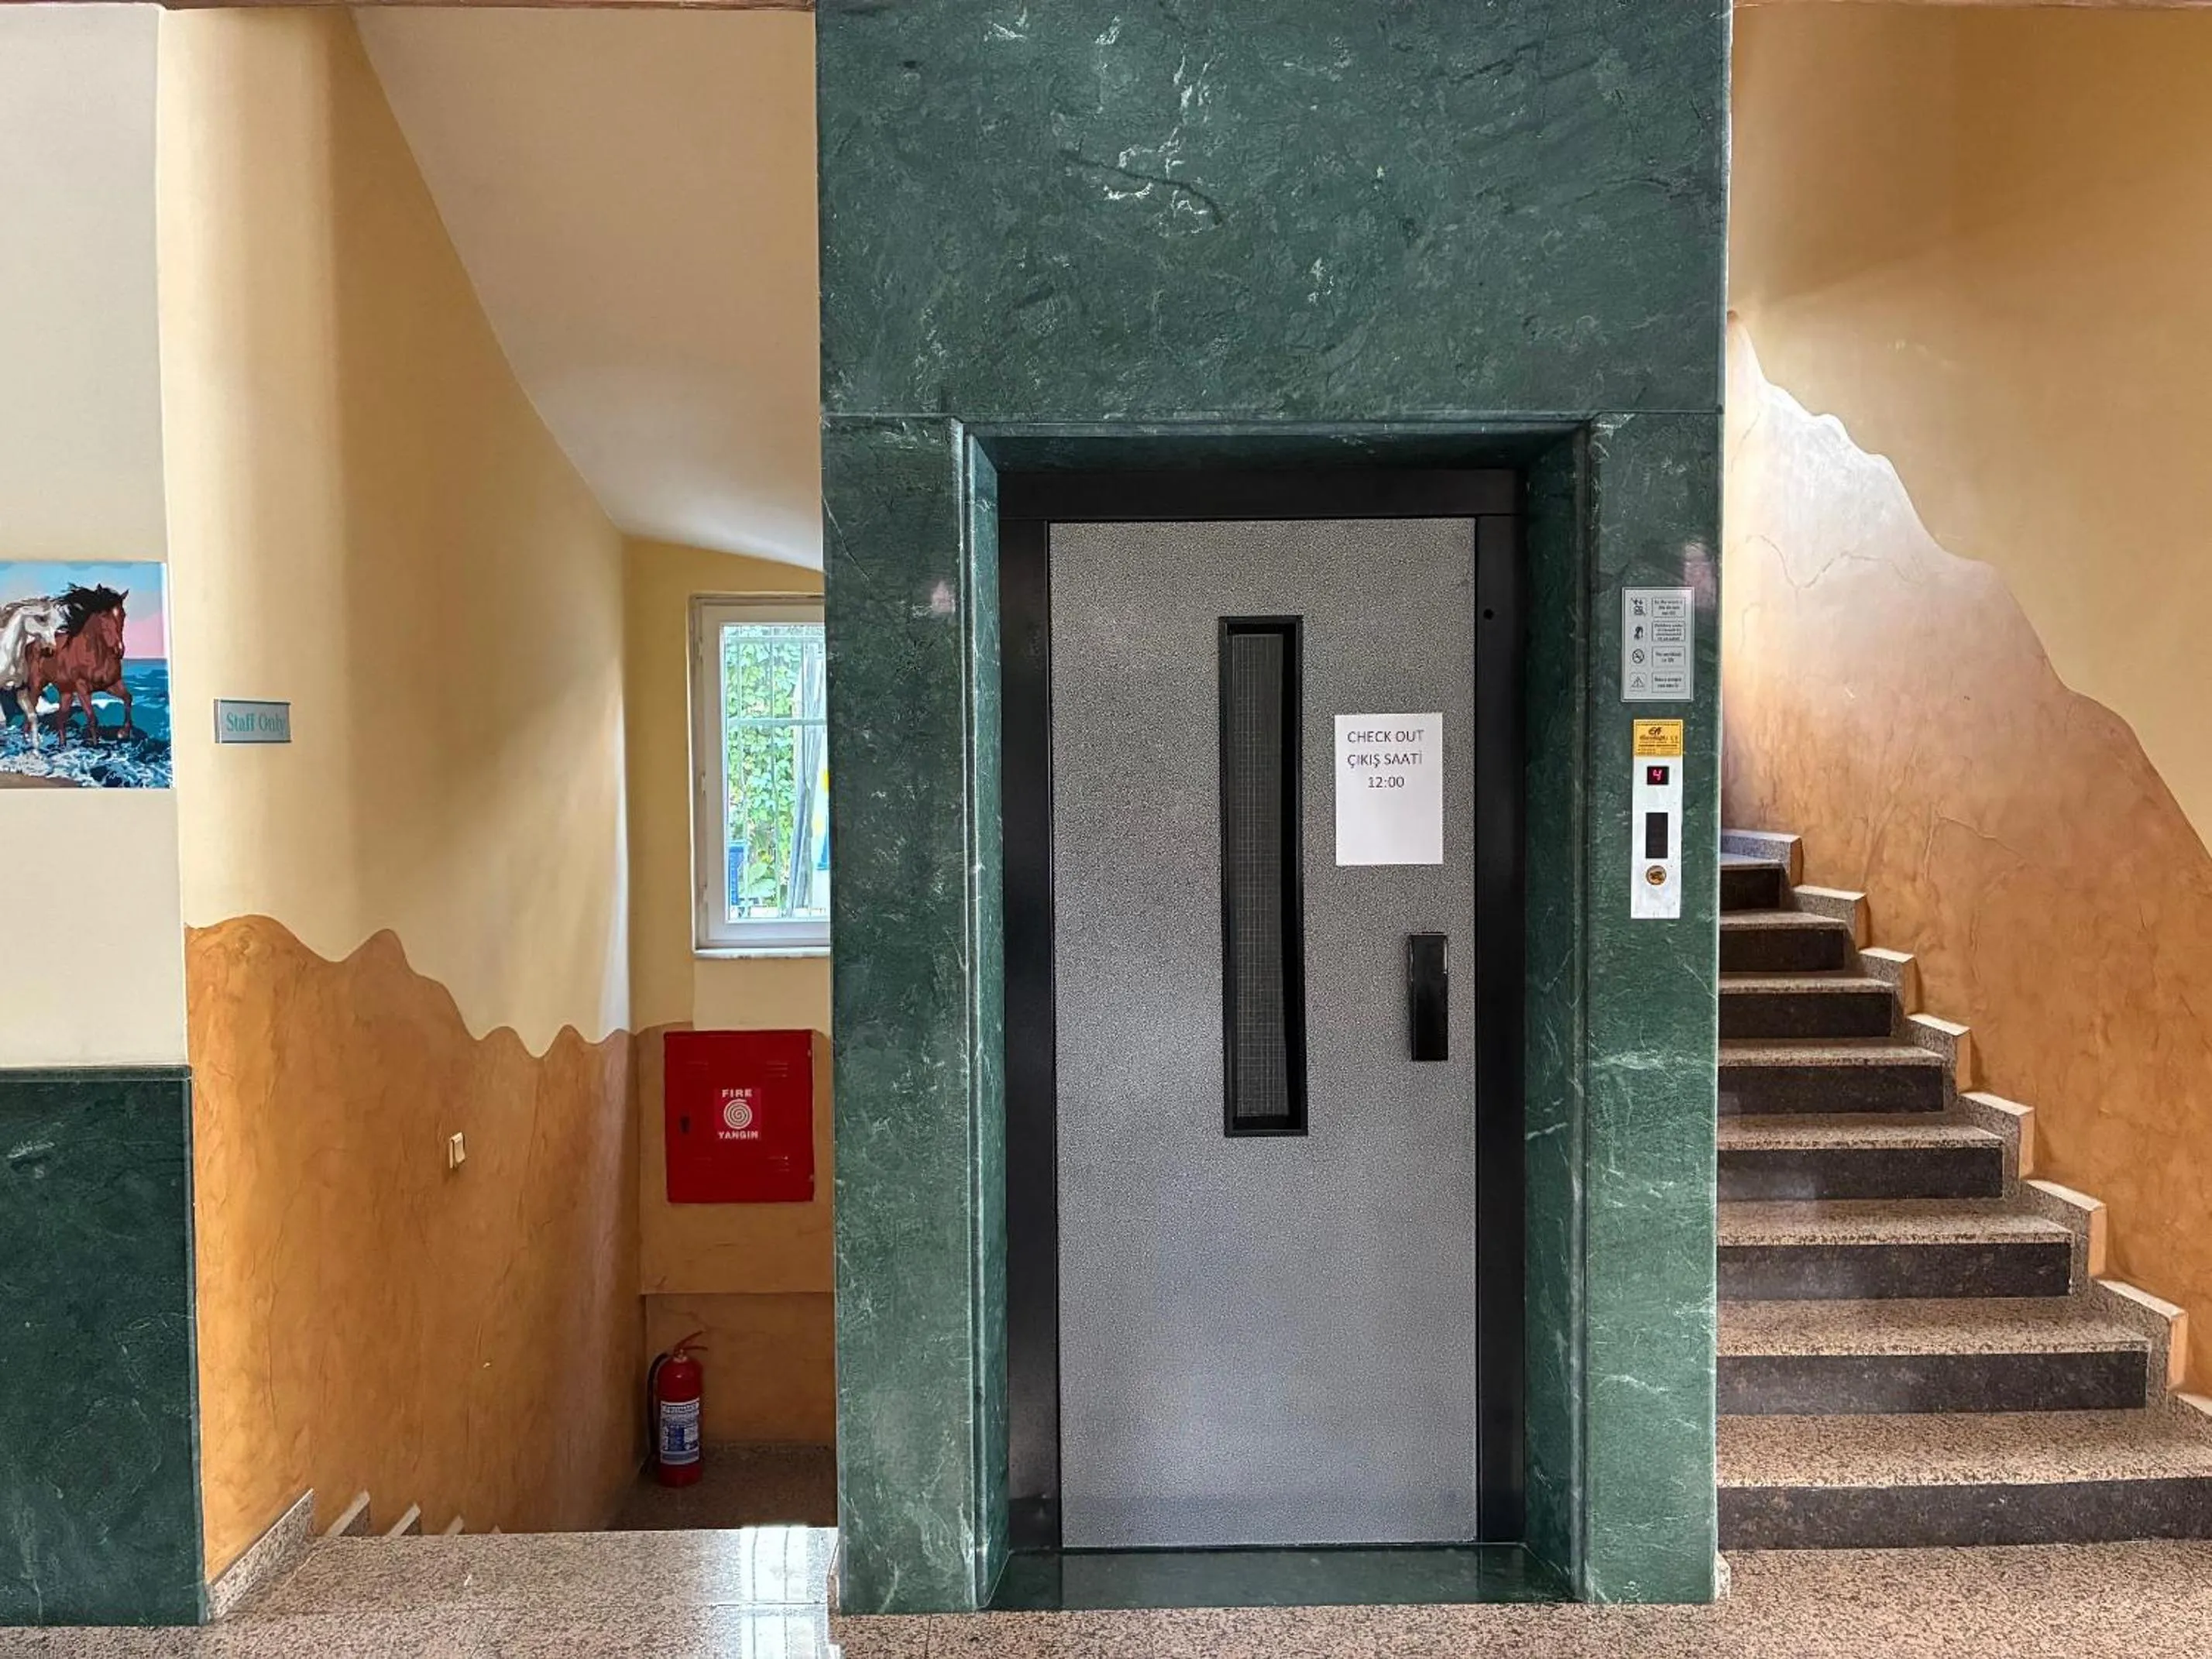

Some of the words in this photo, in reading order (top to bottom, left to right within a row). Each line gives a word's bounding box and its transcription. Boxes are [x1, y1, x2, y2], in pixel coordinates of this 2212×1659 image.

[225, 711, 255, 732] Staff
[258, 712, 287, 737] Only
[1347, 730, 1393, 744] CHECK
[1395, 730, 1425, 743] OUT
[1347, 754, 1381, 769] ÇIKIŞ
[1383, 750, 1424, 766] SAATİ
[1368, 776, 1405, 788] 12:00
[721, 1088, 754, 1098] FIRE
[717, 1130, 760, 1140] YANGIN
